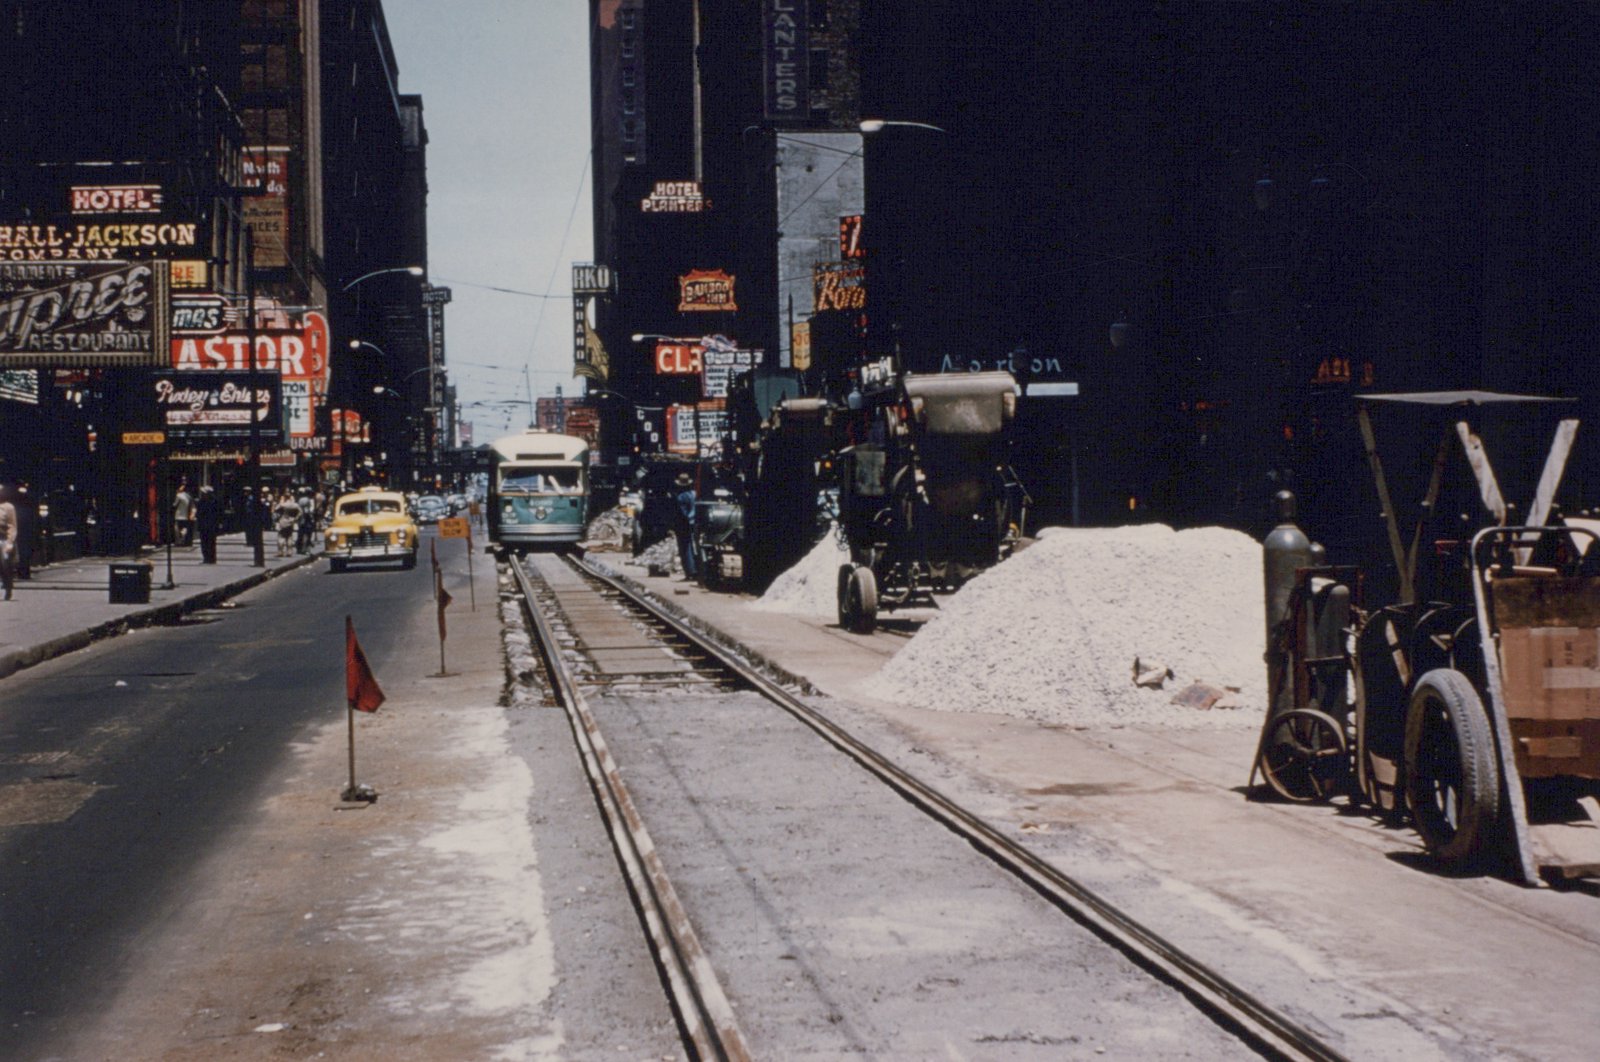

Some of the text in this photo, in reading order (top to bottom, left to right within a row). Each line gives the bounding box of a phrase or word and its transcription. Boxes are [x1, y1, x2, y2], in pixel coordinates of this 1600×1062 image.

[73, 189, 151, 209] HOTEL
[656, 182, 701, 196] HOTEL
[573, 266, 610, 289] RKO
[28, 333, 152, 351] RESTAURANT
[176, 335, 306, 375] ASTOR
